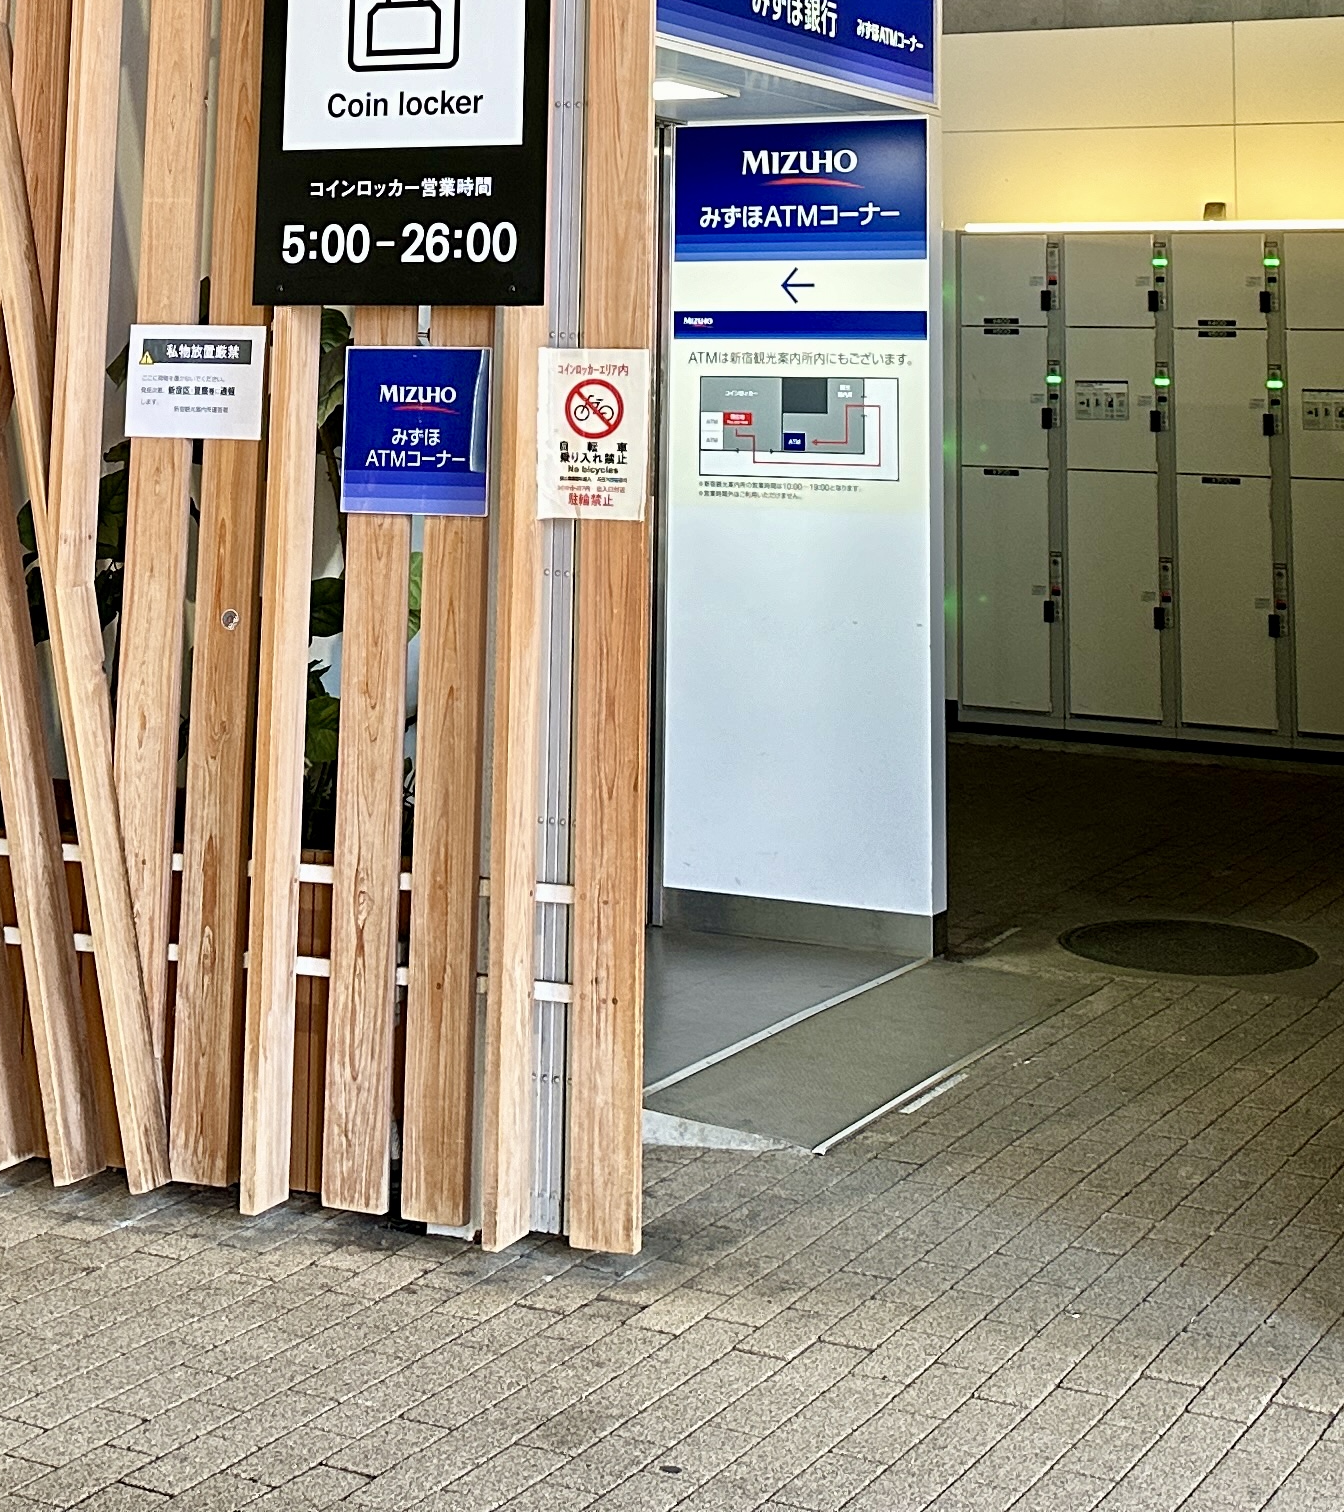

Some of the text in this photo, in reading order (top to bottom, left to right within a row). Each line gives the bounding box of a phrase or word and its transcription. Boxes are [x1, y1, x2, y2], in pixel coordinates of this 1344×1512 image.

[856, 18, 924, 53] みずほATMコーナー
[327, 90, 484, 119] Coin locker
[741, 149, 858, 175] MIZUHO
[309, 175, 492, 197] コインロッカー営業時間
[699, 203, 901, 229] みずほATMコーナー
[166, 343, 240, 359] 私物放置厳禁
[688, 351, 913, 367] ATMは新宿観光案内所内にもございます。
[557, 363, 629, 377] コインロッカーエリア内
[379, 384, 457, 404] MIZUHO
[391, 428, 441, 446] みずほ
[364, 450, 466, 468] ATMコーナー
[560, 452, 628, 465] 乗り入れ禁止
[568, 464, 619, 475] No bicycles
[568, 492, 615, 507] 駐輪禁止
